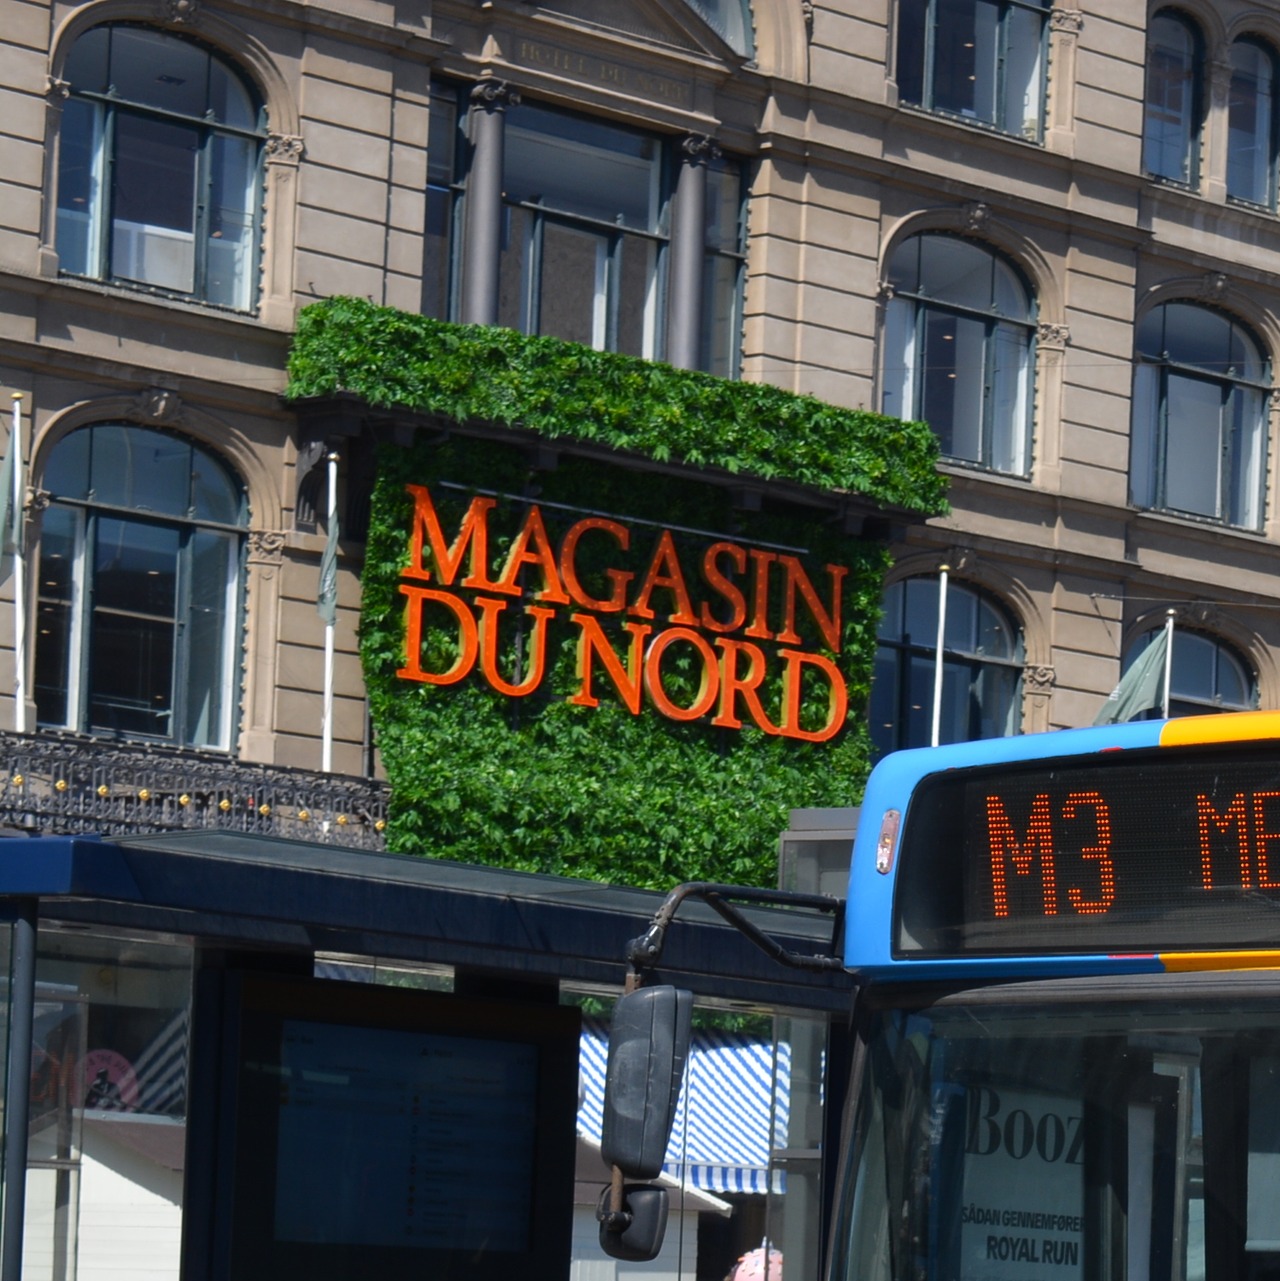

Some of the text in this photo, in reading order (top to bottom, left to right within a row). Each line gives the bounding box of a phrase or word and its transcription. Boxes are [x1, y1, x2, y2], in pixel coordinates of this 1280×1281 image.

[400, 483, 848, 654] MAGASIN
[396, 583, 849, 742] DU NORD
[987, 791, 1115, 917] M3
[961, 1203, 1002, 1226] SÅDAN
[986, 1235, 1079, 1266] ROYAL RUN
